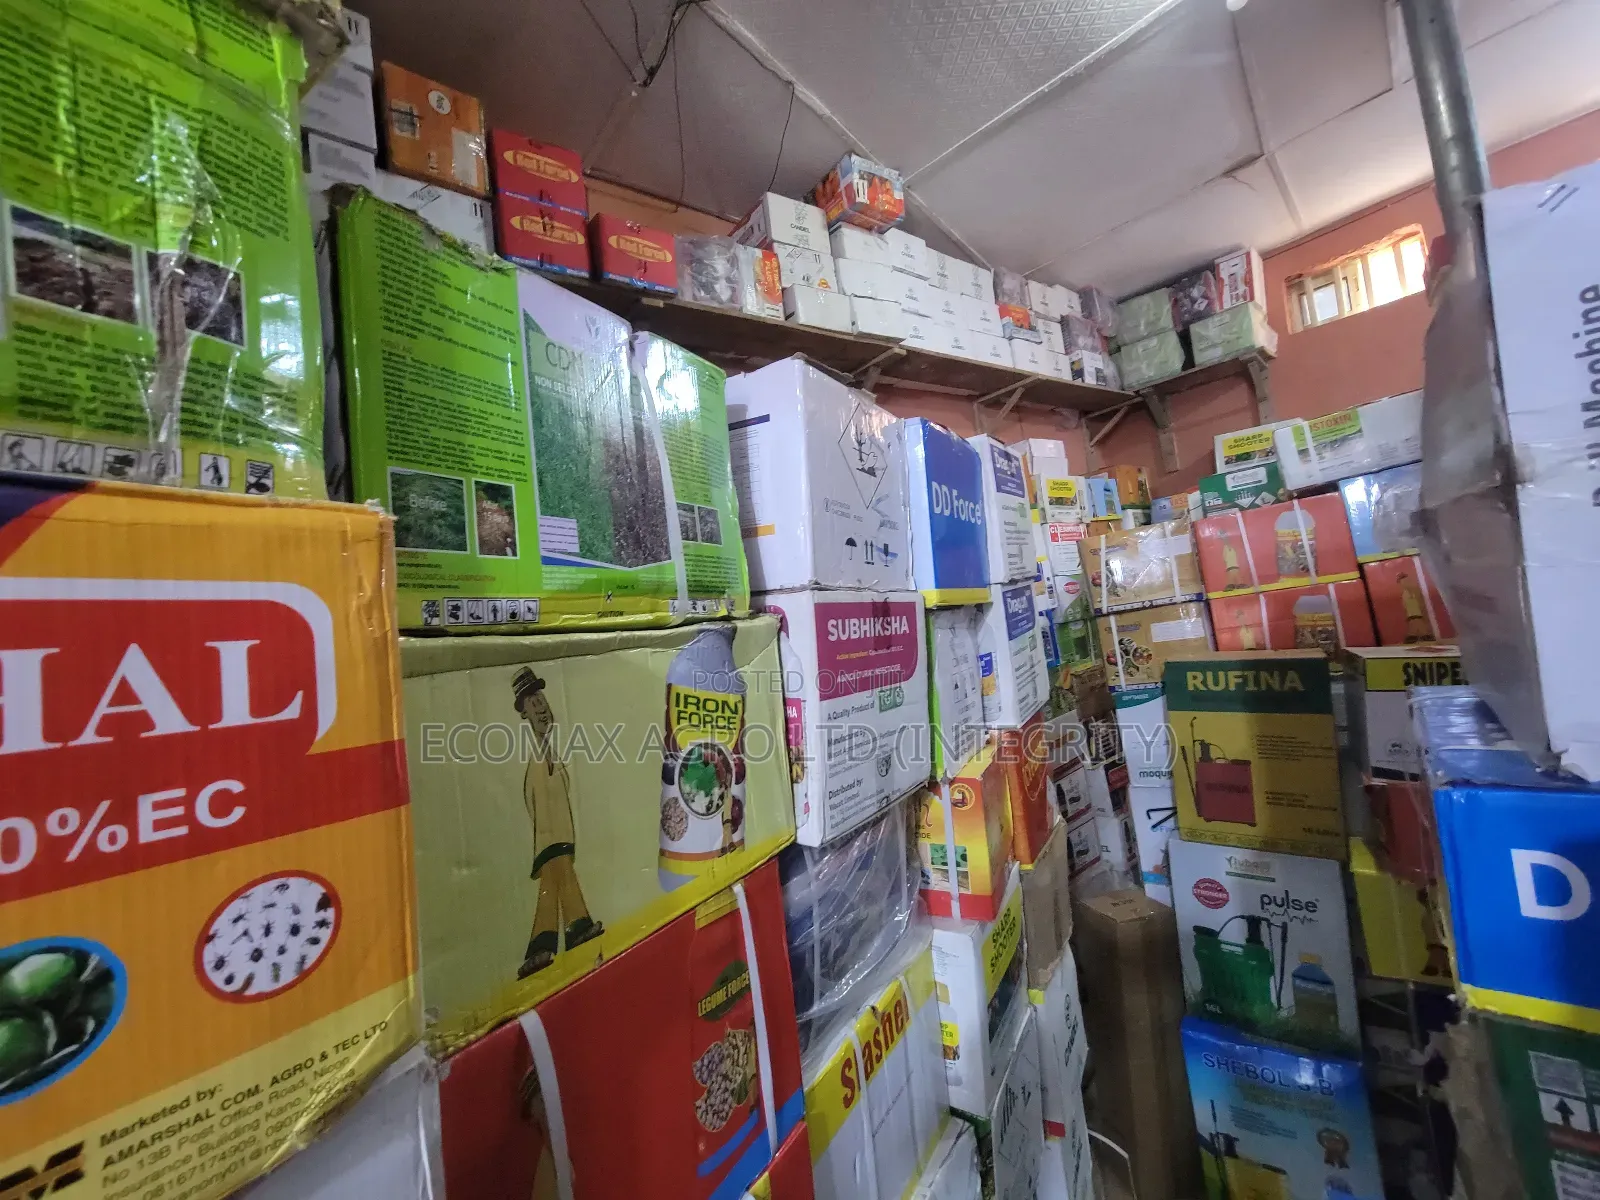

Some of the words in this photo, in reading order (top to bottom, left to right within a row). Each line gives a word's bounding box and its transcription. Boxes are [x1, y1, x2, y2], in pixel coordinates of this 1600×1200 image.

[1228, 437, 1272, 450] SHOOTER
[1233, 433, 1264, 444] SHARP
[409, 494, 448, 512] Before
[827, 615, 910, 642] SUBHIKSHA
[1186, 670, 1306, 692] RUFINA
[1402, 661, 1469, 687] SNIPE
[674, 692, 739, 715] IRON
[833, 707, 850, 721] Quality
[851, 702, 869, 715] Product
[869, 701, 875, 710] of
[676, 710, 738, 731] FORCE
[828, 780, 856, 800] Distributed
[1193, 888, 1229, 900] STRONGER
[1260, 889, 1320, 914] pulse
[992, 907, 1012, 943] SHARP
[697, 989, 727, 1018] LEGUME
[1202, 1052, 1290, 1089] SHEBOL
[101, 1108, 215, 1171] AMARSHAL
[221, 1086, 264, 1112] COM.
[269, 1058, 316, 1087] AGRO
[318, 1051, 328, 1063] &
[333, 1034, 360, 1056] TEC
[364, 1020, 389, 1040] LTD
[100, 1095, 191, 1149] Marketed
[195, 1081, 225, 1103] by:
[102, 1167, 130, 1190] No
[137, 1146, 172, 1169] 13B
[177, 1124, 215, 1151] Post
[219, 1102, 265, 1128] Office
[101, 1154, 193, 1200] Insurance
[198, 1118, 261, 1158] Building
